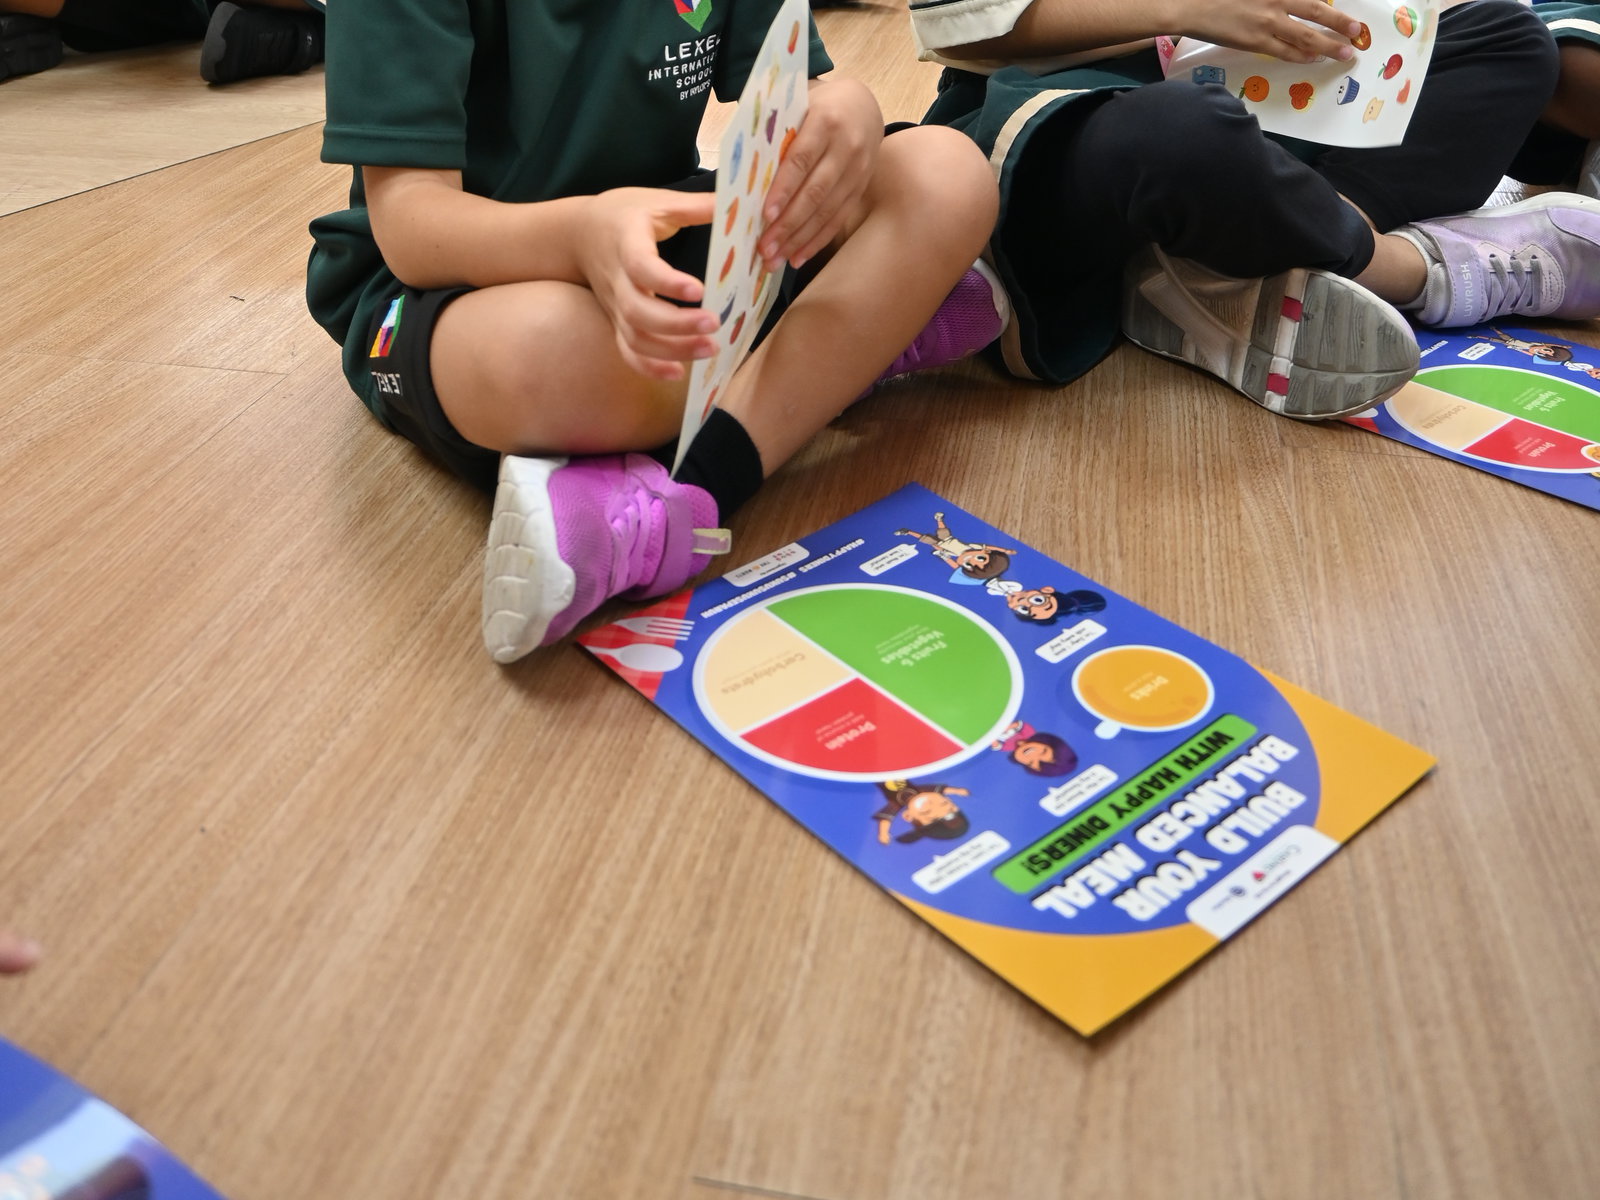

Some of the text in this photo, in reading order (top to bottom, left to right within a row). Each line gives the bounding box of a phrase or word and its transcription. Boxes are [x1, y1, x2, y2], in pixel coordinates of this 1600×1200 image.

[676, 66, 713, 89] SCHOOL
[680, 89, 690, 101] BY
[798, 538, 865, 573] #HAPPYDINERS
[881, 631, 944, 664] Vegetables
[901, 640, 947, 666] Fruits &
[1130, 676, 1169, 700] Drinks
[825, 721, 876, 750] Protein
[1174, 731, 1234, 771] WITH
[1109, 767, 1181, 819] HAPPY
[1134, 735, 1299, 852] BALANCED
[1205, 781, 1307, 854] BUILD
[1027, 815, 1110, 875] DINERS!
[1032, 843, 1146, 918] MEAL
[1113, 850, 1221, 921] YOUR
